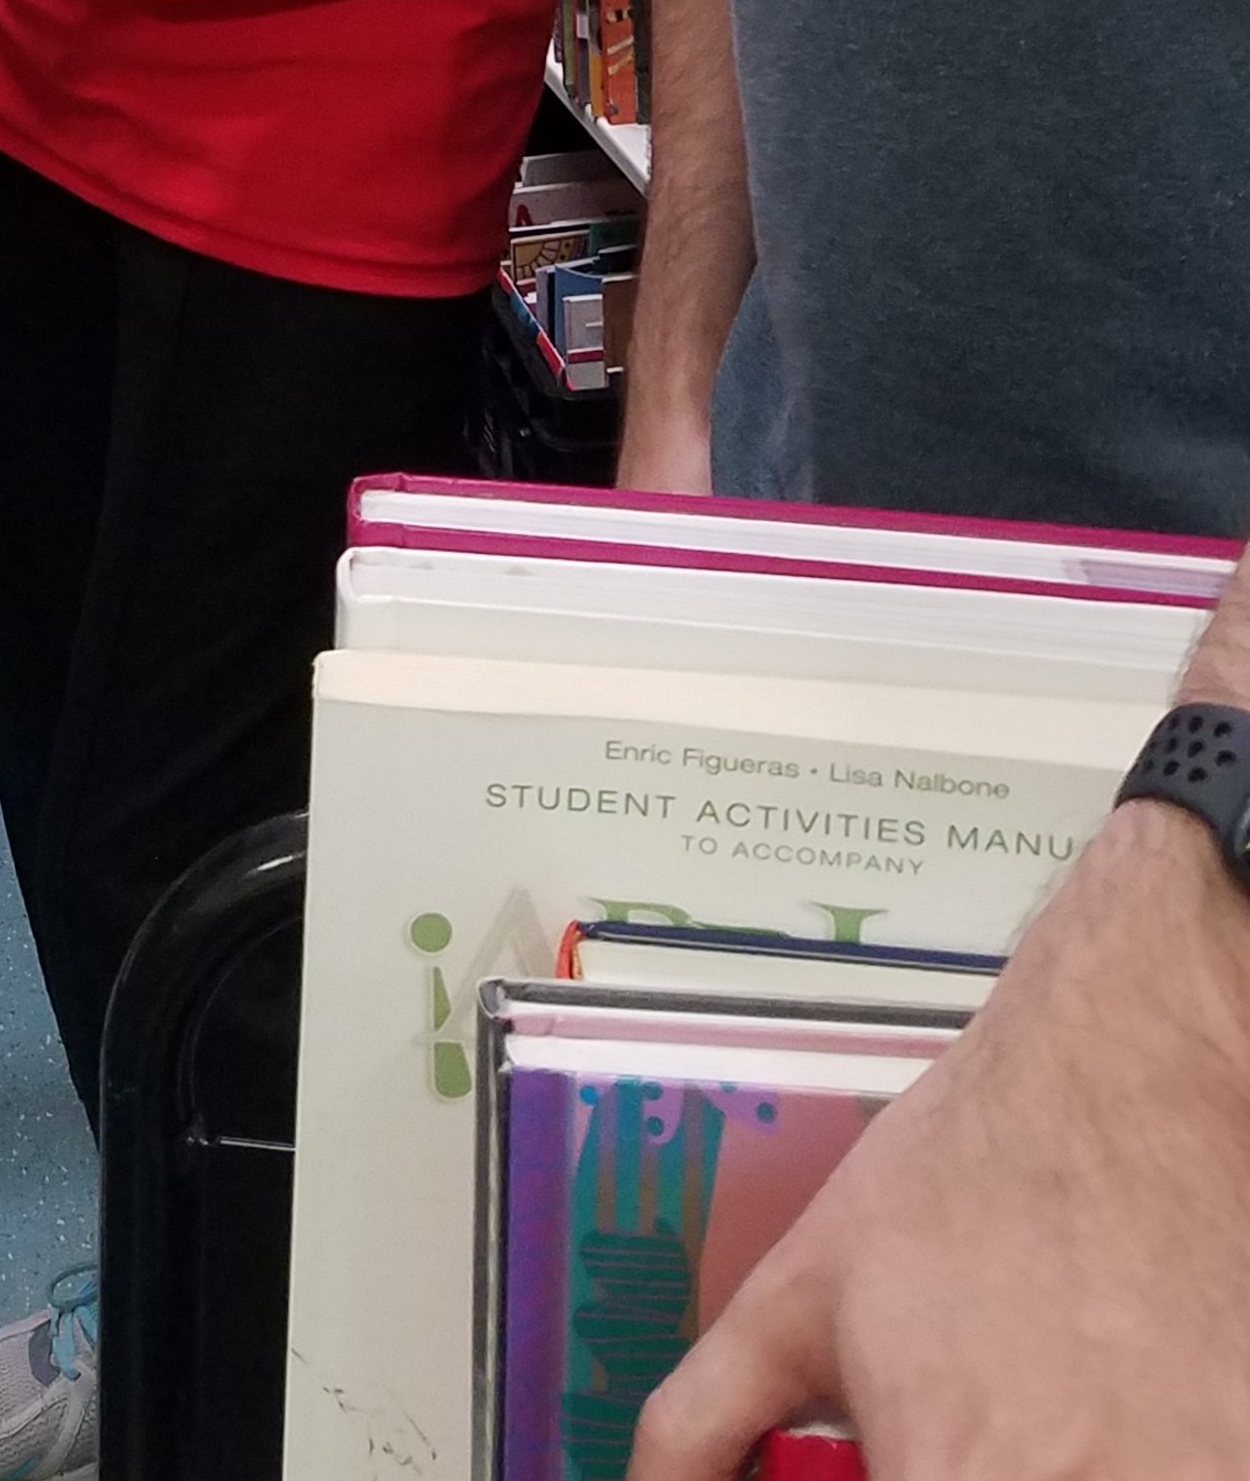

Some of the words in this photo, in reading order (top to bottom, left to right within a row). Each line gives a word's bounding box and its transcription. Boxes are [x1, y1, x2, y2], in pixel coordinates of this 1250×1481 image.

[605, 740, 672, 767] Enric
[682, 747, 800, 779] Figueras
[829, 762, 884, 789] Lisa
[894, 769, 1011, 800] Nalbone
[484, 783, 677, 820] STUDENT
[696, 800, 928, 846] ACTIVITIES
[681, 834, 718, 856] TO
[731, 841, 926, 877] ACCOMPANY
